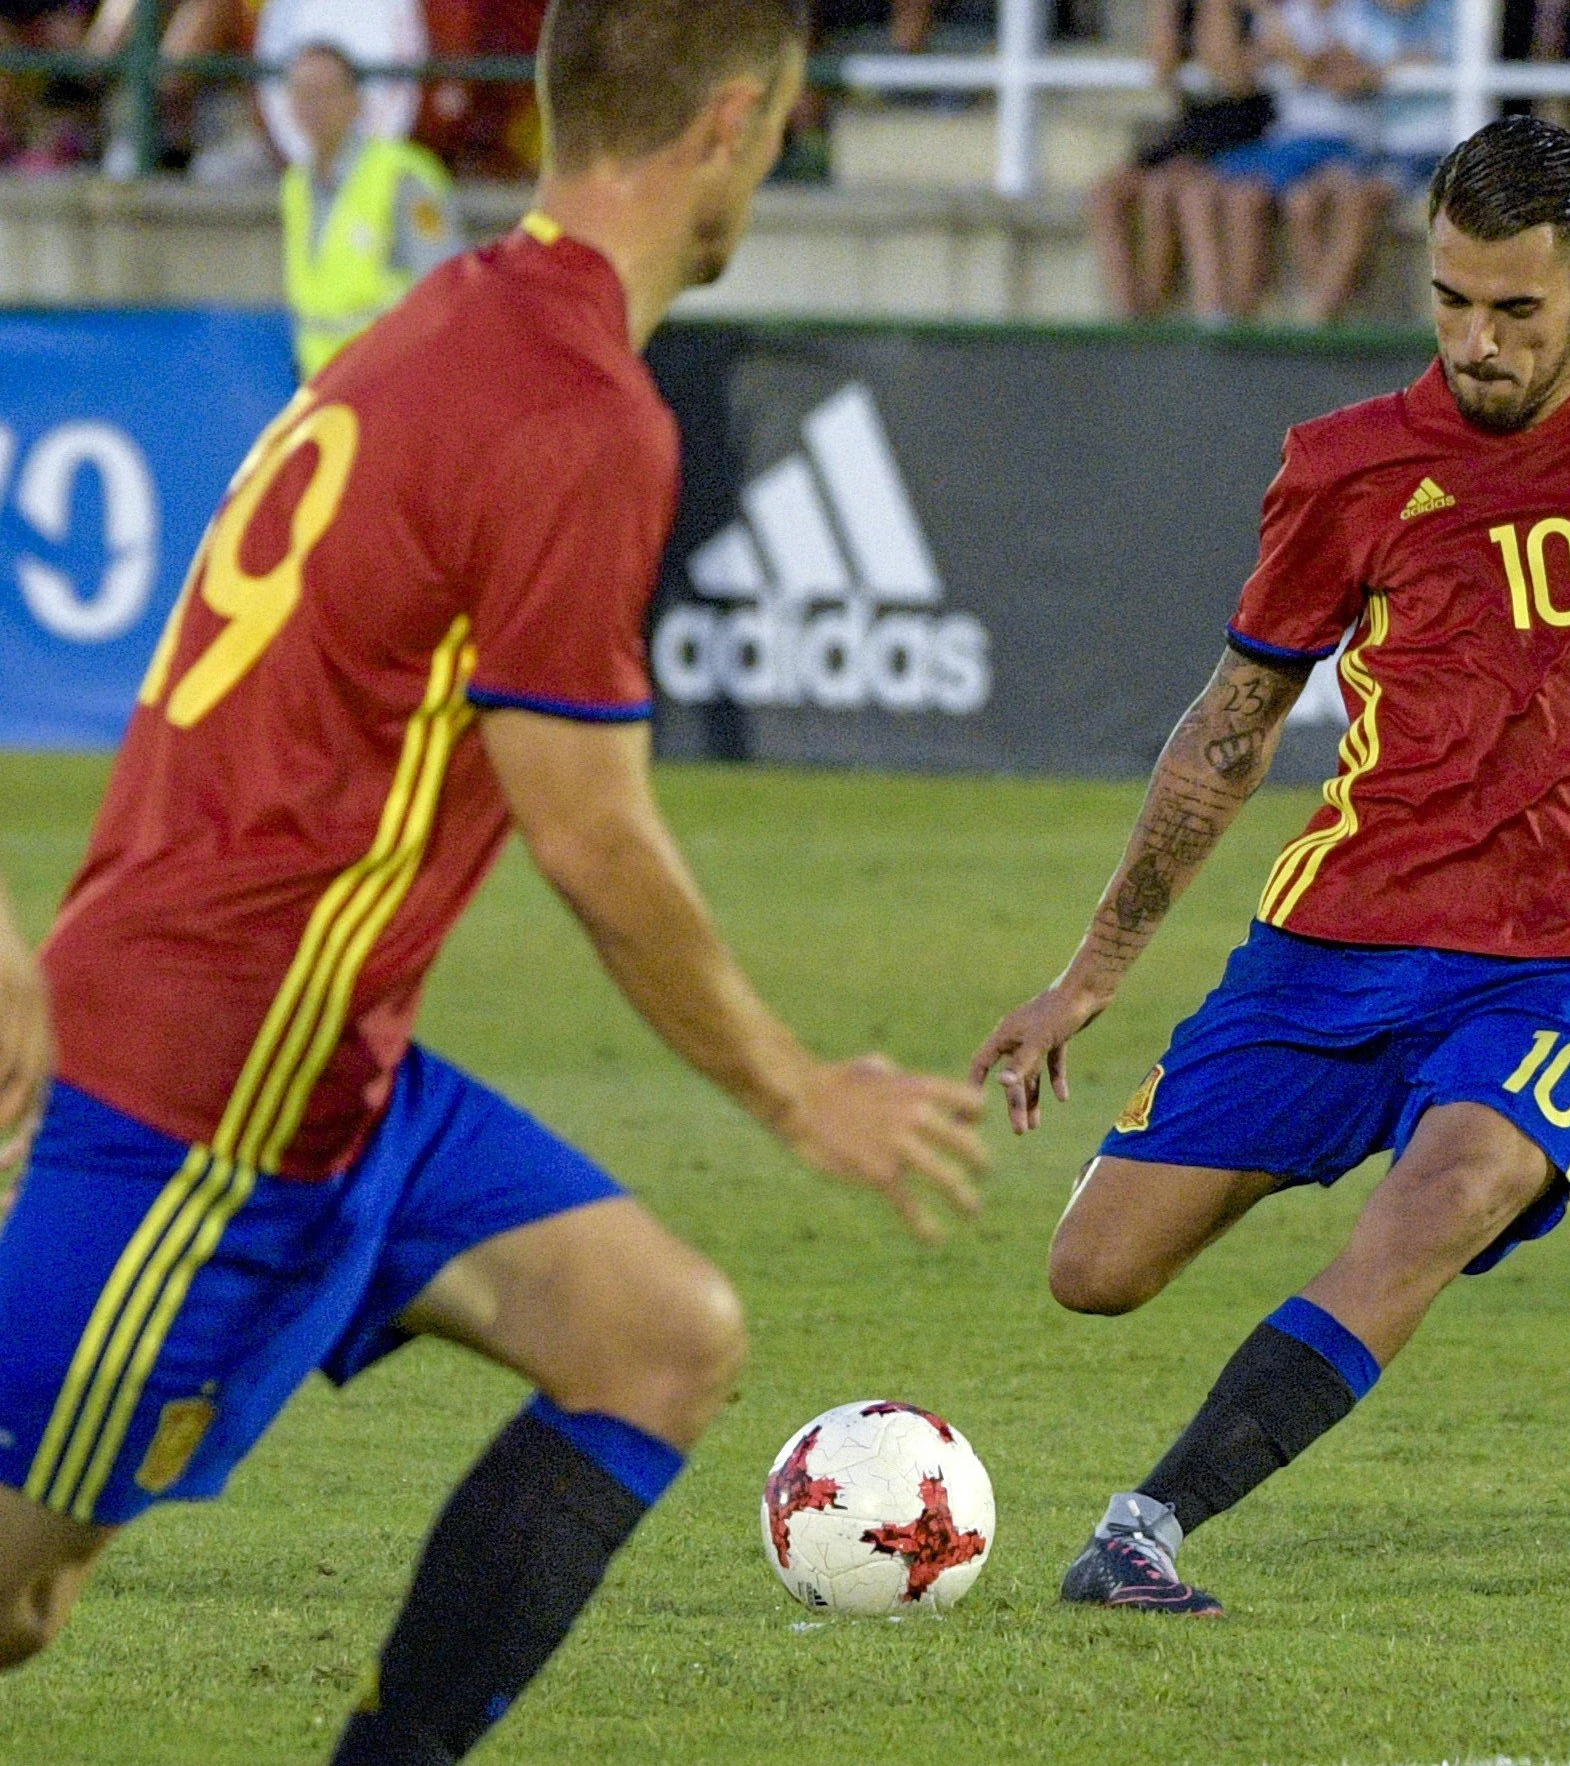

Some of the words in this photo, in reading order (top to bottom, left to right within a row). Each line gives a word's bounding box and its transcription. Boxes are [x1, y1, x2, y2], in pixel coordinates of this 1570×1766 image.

[1400, 495, 1456, 520] adidas
[652, 597, 991, 715] adidas
[1223, 678, 1264, 716] 23
